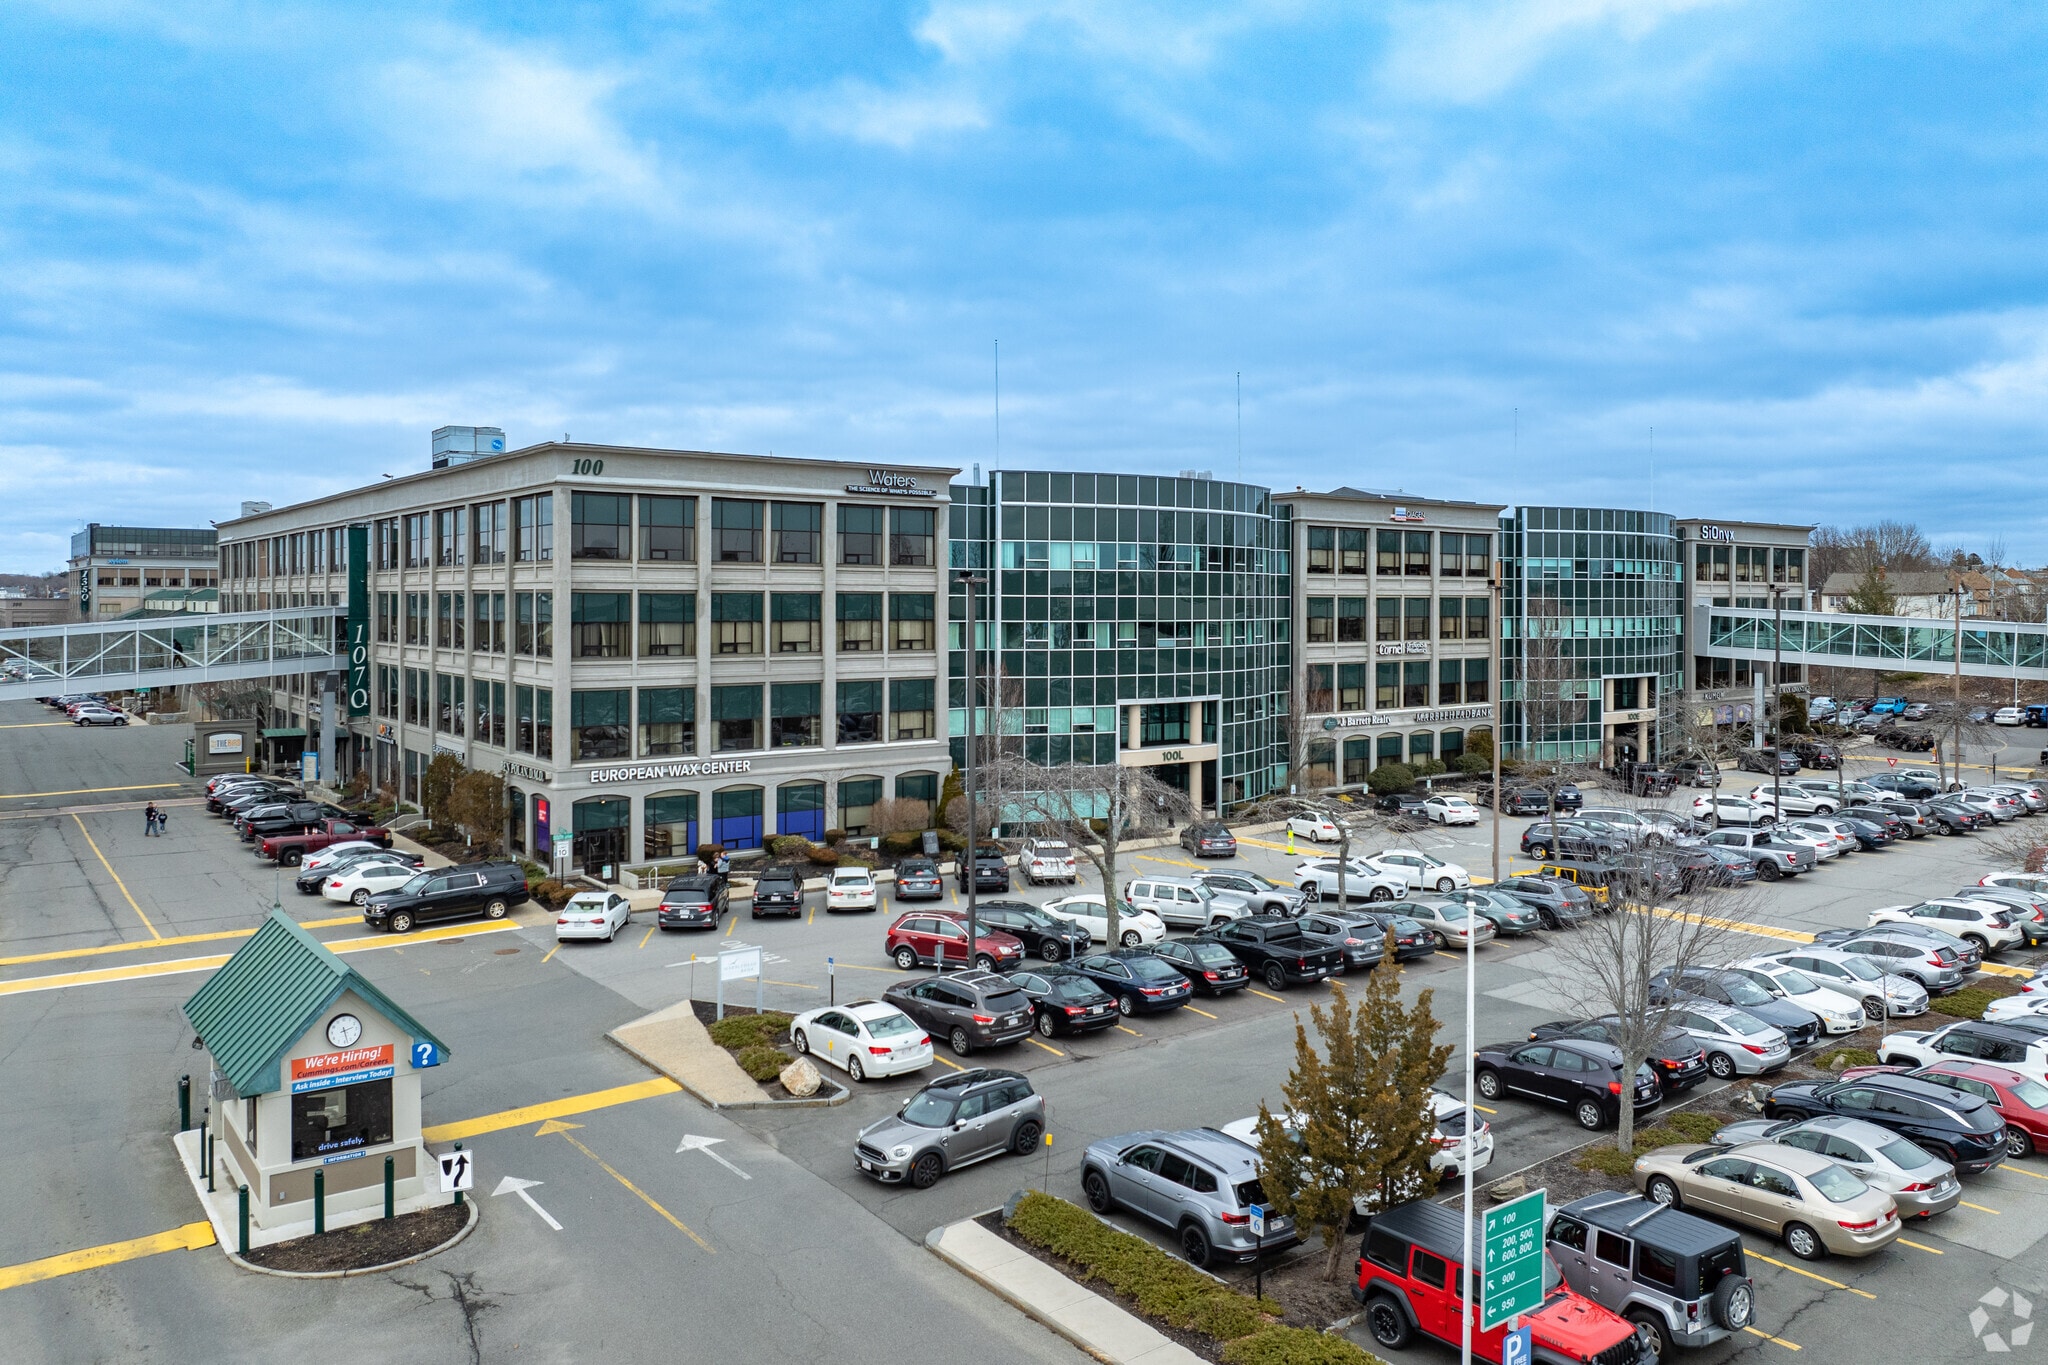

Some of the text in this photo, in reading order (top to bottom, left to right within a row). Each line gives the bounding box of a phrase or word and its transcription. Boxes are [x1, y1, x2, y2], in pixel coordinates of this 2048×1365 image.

[571, 458, 604, 476] 100
[868, 469, 917, 487] Waters
[1701, 525, 1735, 544] SiOnyx
[350, 623, 369, 709] 107Q
[1162, 750, 1184, 761] 100L
[590, 760, 751, 783] EUROPEAN WAX CENTER
[305, 1046, 382, 1070] We're Hiring!
[296, 1058, 389, 1080] Cummings.com/Careers
[295, 1081, 309, 1091] Ask
[309, 1078, 331, 1089] inside
[335, 1073, 368, 1084] Interview
[369, 1067, 393, 1079] Today!
[318, 1141, 339, 1151] drive
[340, 1136, 365, 1147] safely.
[328, 1152, 362, 1163] INFORMATION
[1253, 1220, 1260, 1231] 6
[1502, 1212, 1517, 1226] 100
[1502, 1227, 1535, 1249] 200, 500,
[1502, 1240, 1533, 1263] 600, 800
[1501, 1271, 1516, 1286] 900
[1501, 1297, 1516, 1312] 950
[1506, 1334, 1522, 1365] P
